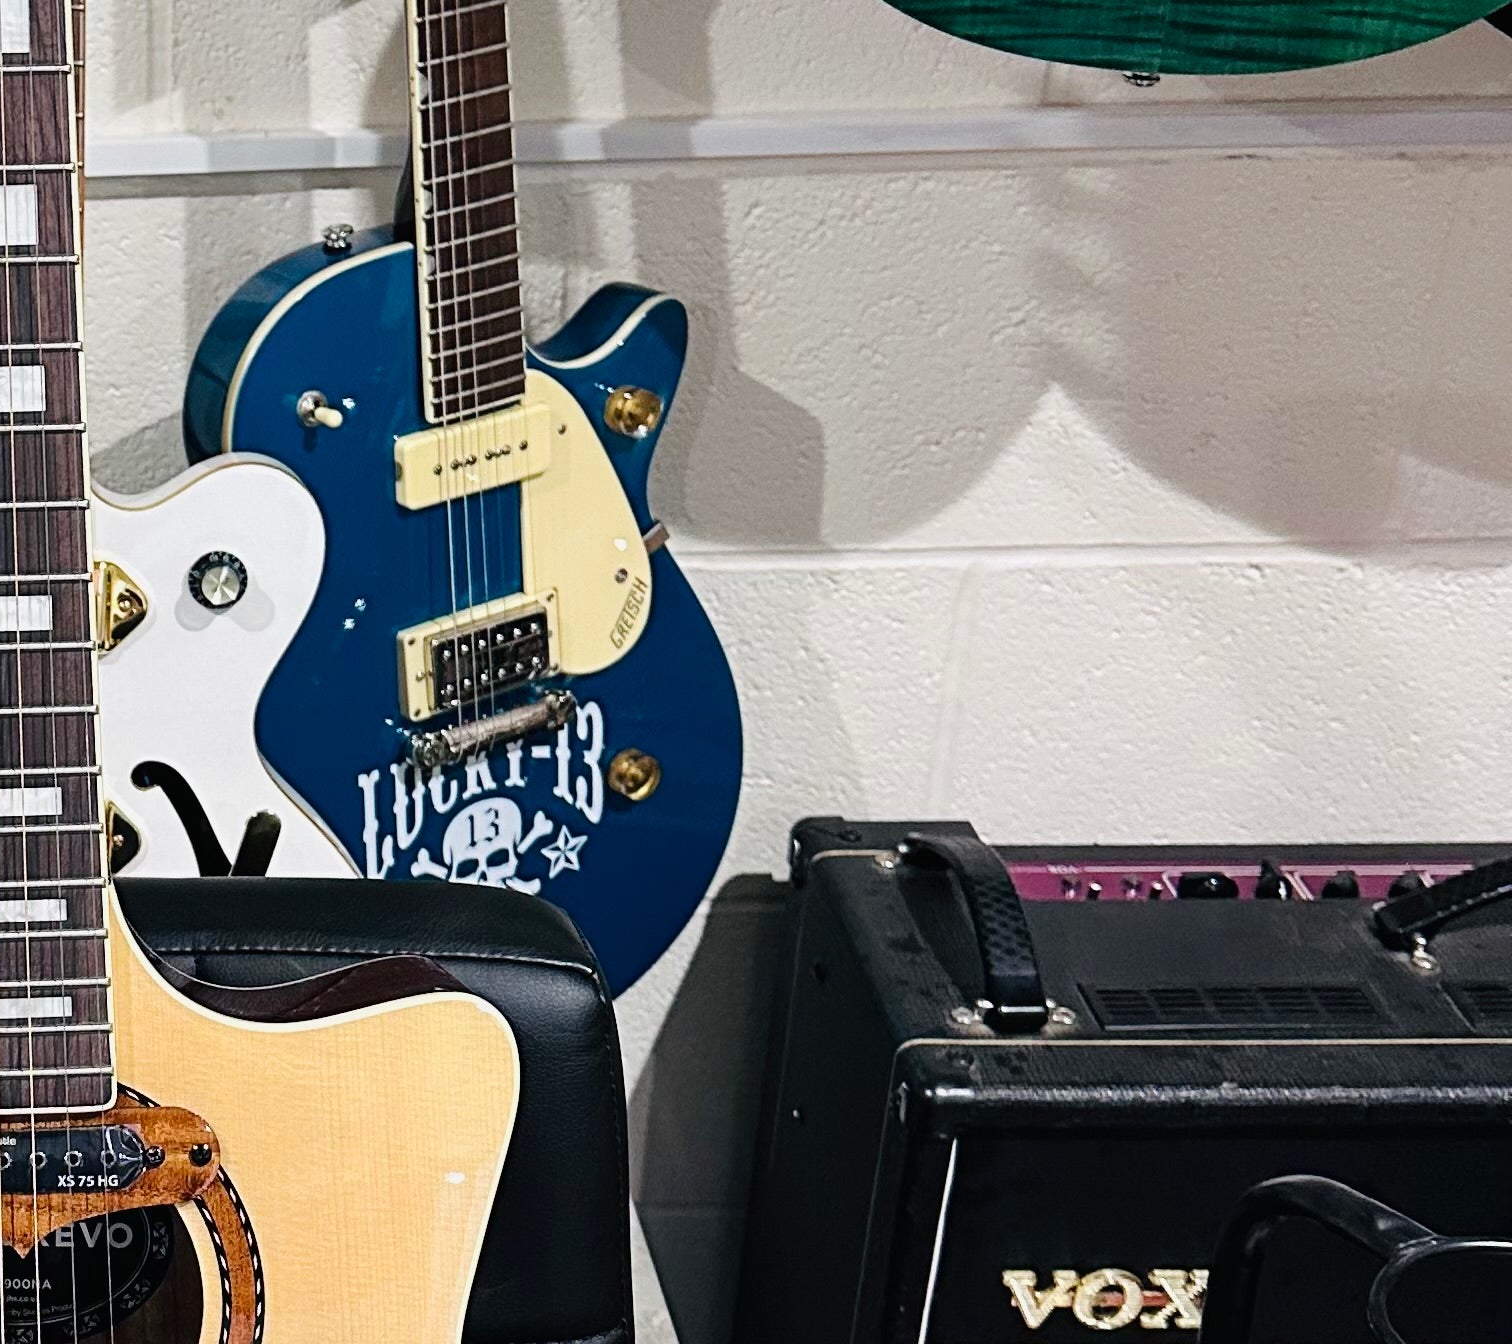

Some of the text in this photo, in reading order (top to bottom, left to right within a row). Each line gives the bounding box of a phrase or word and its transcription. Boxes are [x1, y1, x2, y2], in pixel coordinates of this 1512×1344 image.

[610, 576, 648, 649] GRETSCH
[465, 808, 499, 848] 13
[57, 1174, 119, 1187] XS 75 HG
[40, 1221, 133, 1248] EVO
[1002, 1268, 1209, 1329] VOX
